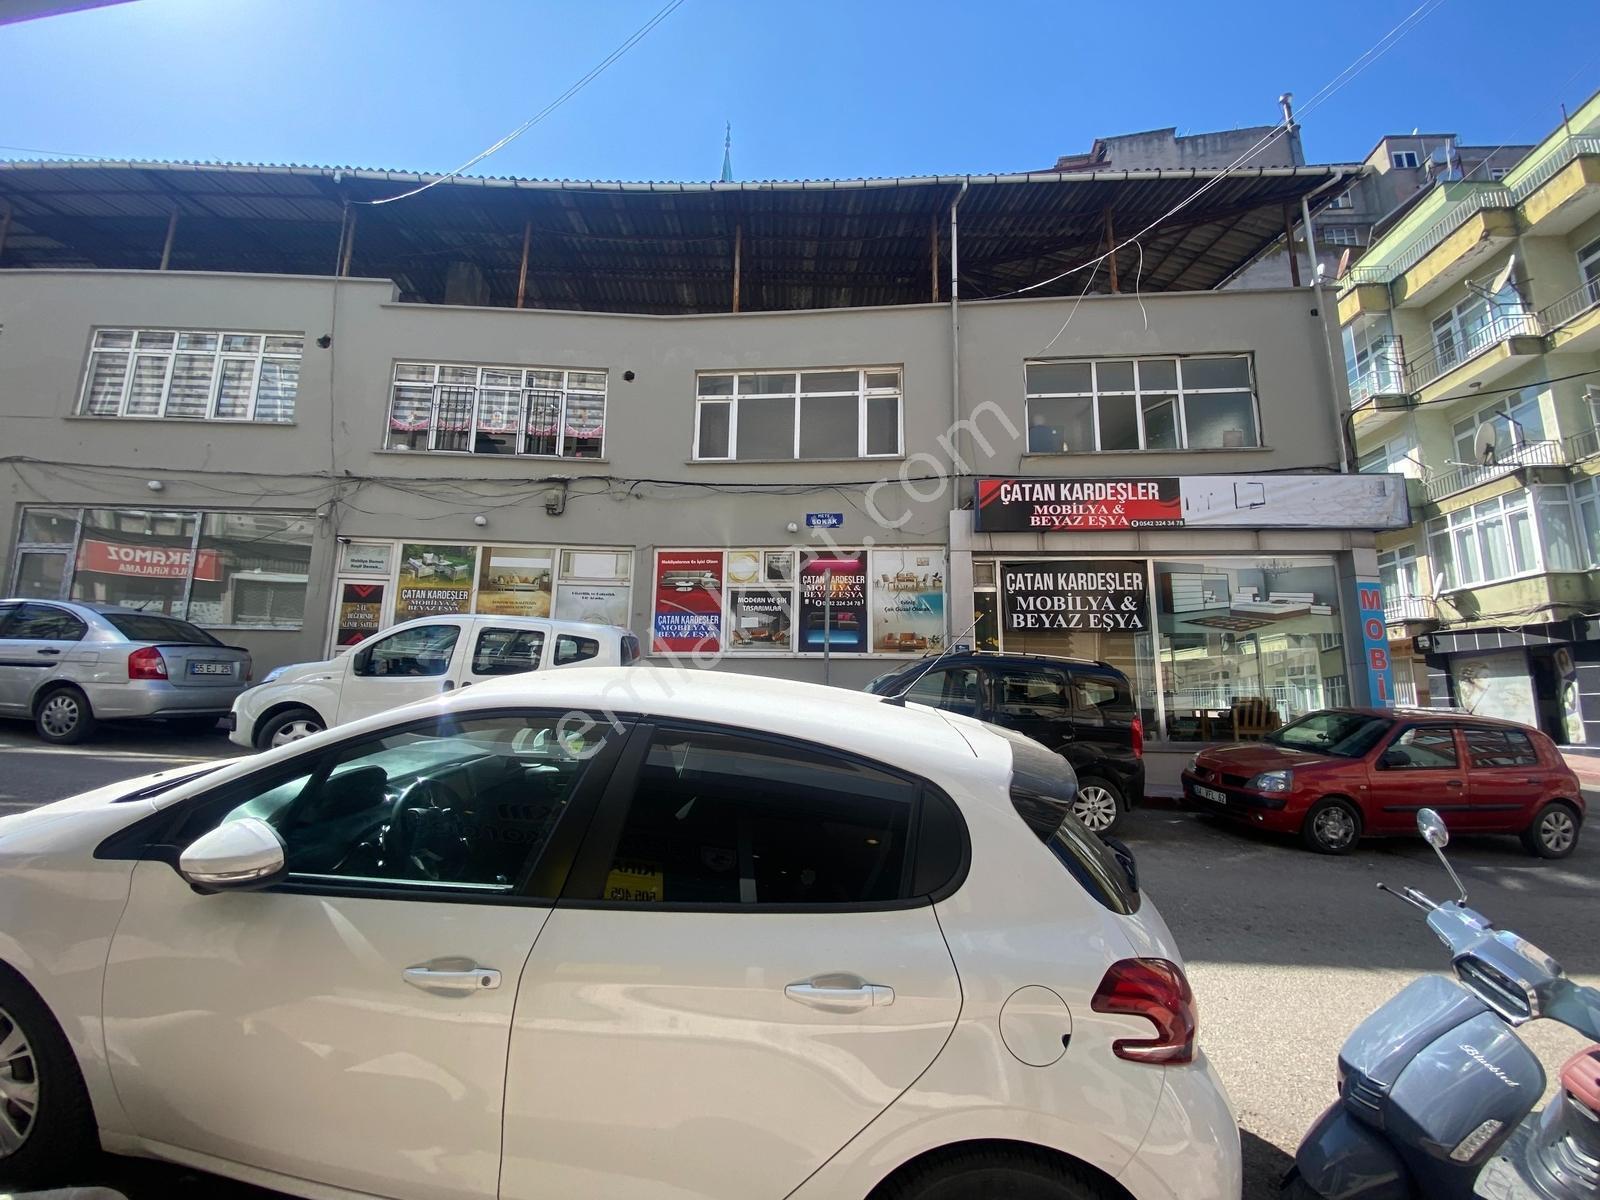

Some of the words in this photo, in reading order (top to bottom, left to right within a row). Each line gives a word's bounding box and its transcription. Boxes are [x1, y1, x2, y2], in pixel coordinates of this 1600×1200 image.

[1000, 483, 1055, 505] ÇATAN
[1060, 482, 1159, 504] KARDEŞLER
[1033, 502, 1108, 515] MOBİLYA
[1112, 504, 1125, 514] &
[1030, 516, 1084, 527] BEYAZ
[1088, 515, 1129, 528] EŞYA
[802, 575, 825, 585] ÇATAN
[827, 575, 865, 585] ARDEŞLER
[1006, 573, 1054, 594] ÇATAN
[1058, 572, 1143, 594] KARDEŞLER
[402, 589, 426, 600] ÇATAN
[427, 590, 469, 601] KARDEŞLER
[838, 591, 864, 599] EŞYA
[1016, 593, 1116, 611] MOBİLYA
[1120, 596, 1138, 611] &
[657, 615, 680, 626] ÇATAN
[681, 615, 719, 625] KARDEŞLER
[1011, 613, 1082, 628] BEYAZ
[1088, 613, 1143, 632] EŞYA
